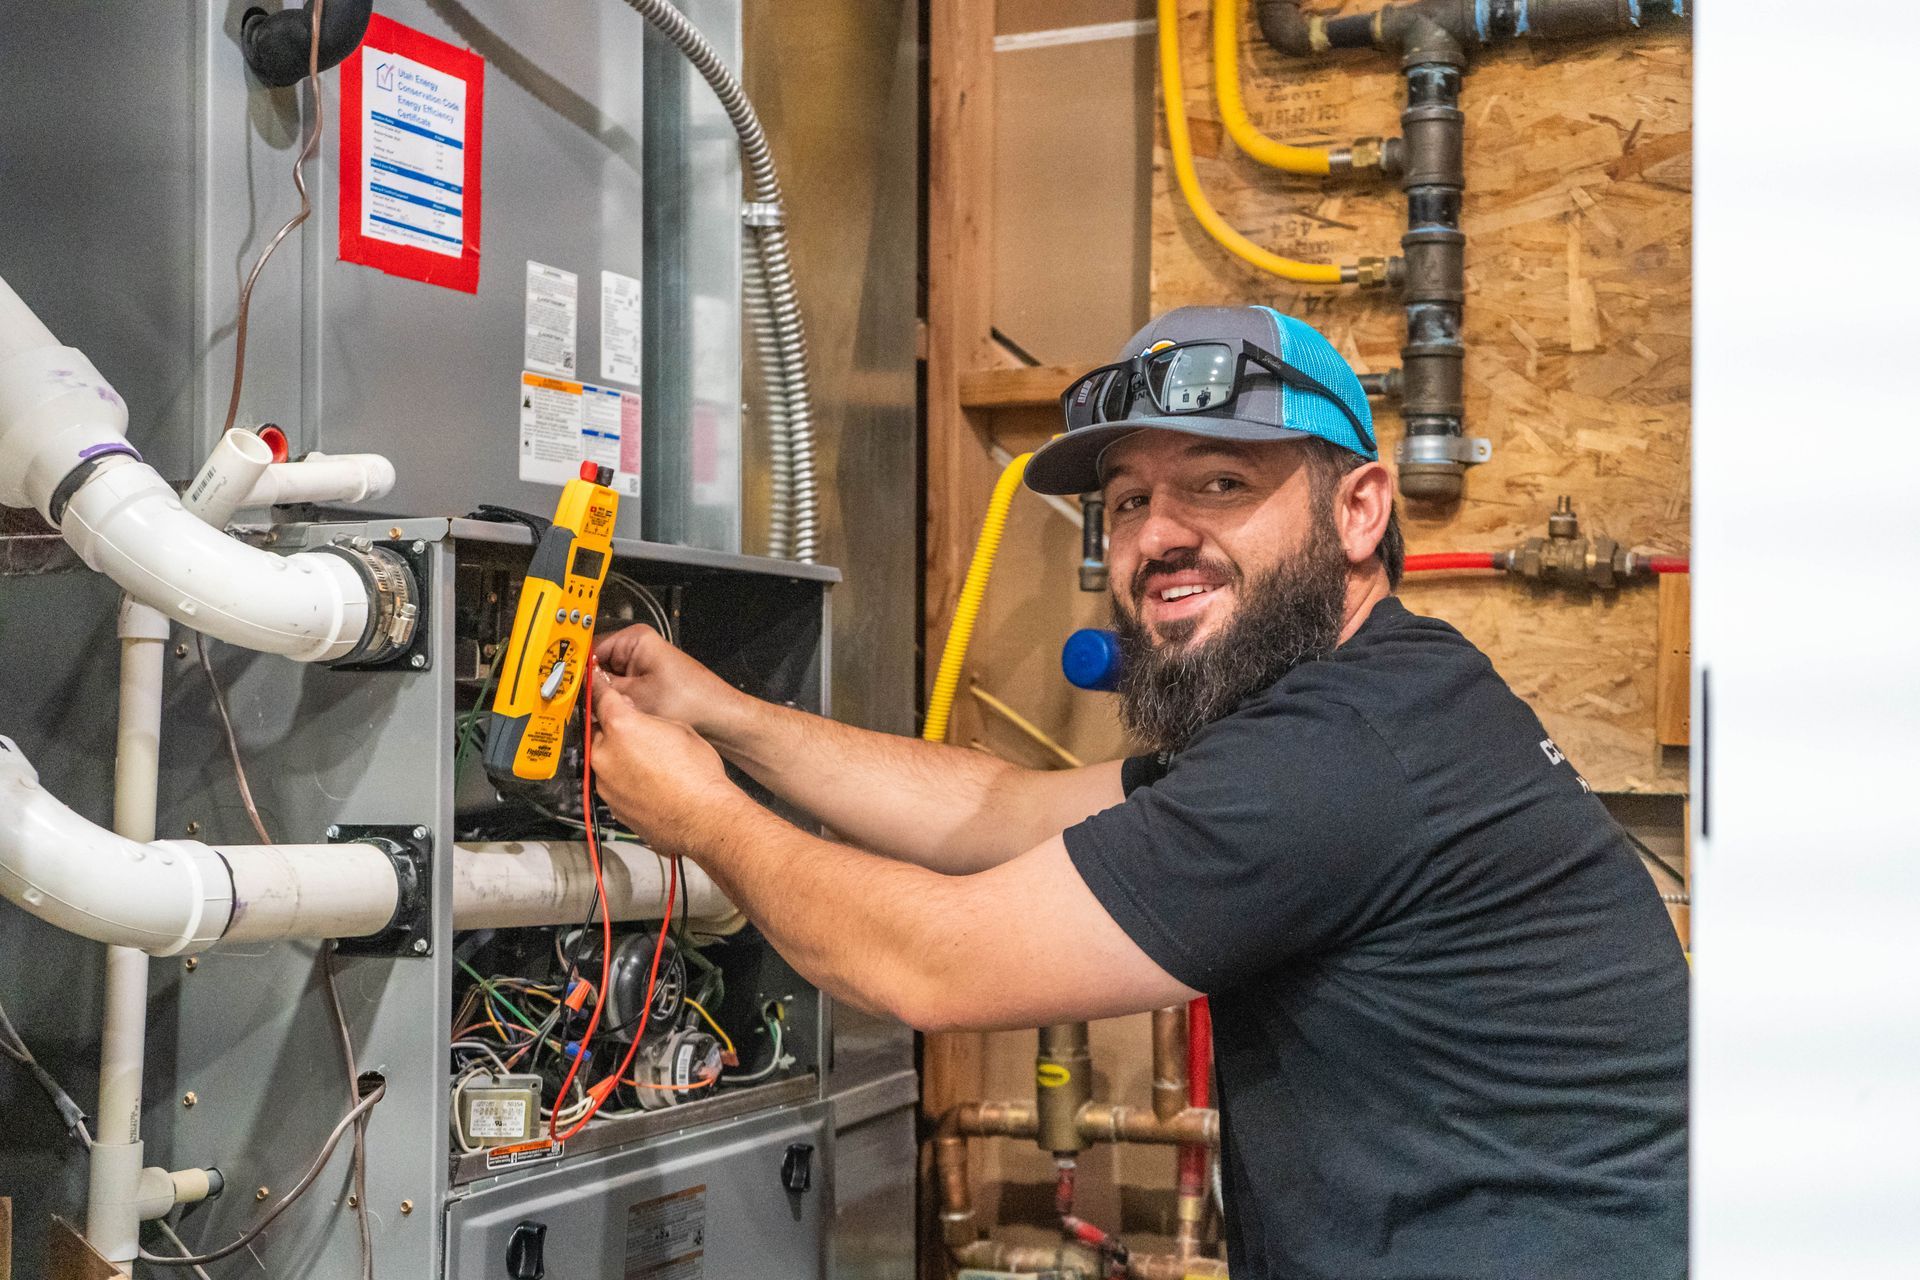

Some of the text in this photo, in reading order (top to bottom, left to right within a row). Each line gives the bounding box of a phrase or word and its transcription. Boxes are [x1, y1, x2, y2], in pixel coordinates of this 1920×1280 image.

[398, 68, 439, 92] Utah Energy
[397, 81, 460, 112] Conservation Code
[397, 94, 455, 125] Energy Efficiency
[397, 108, 432, 128] Certificate
